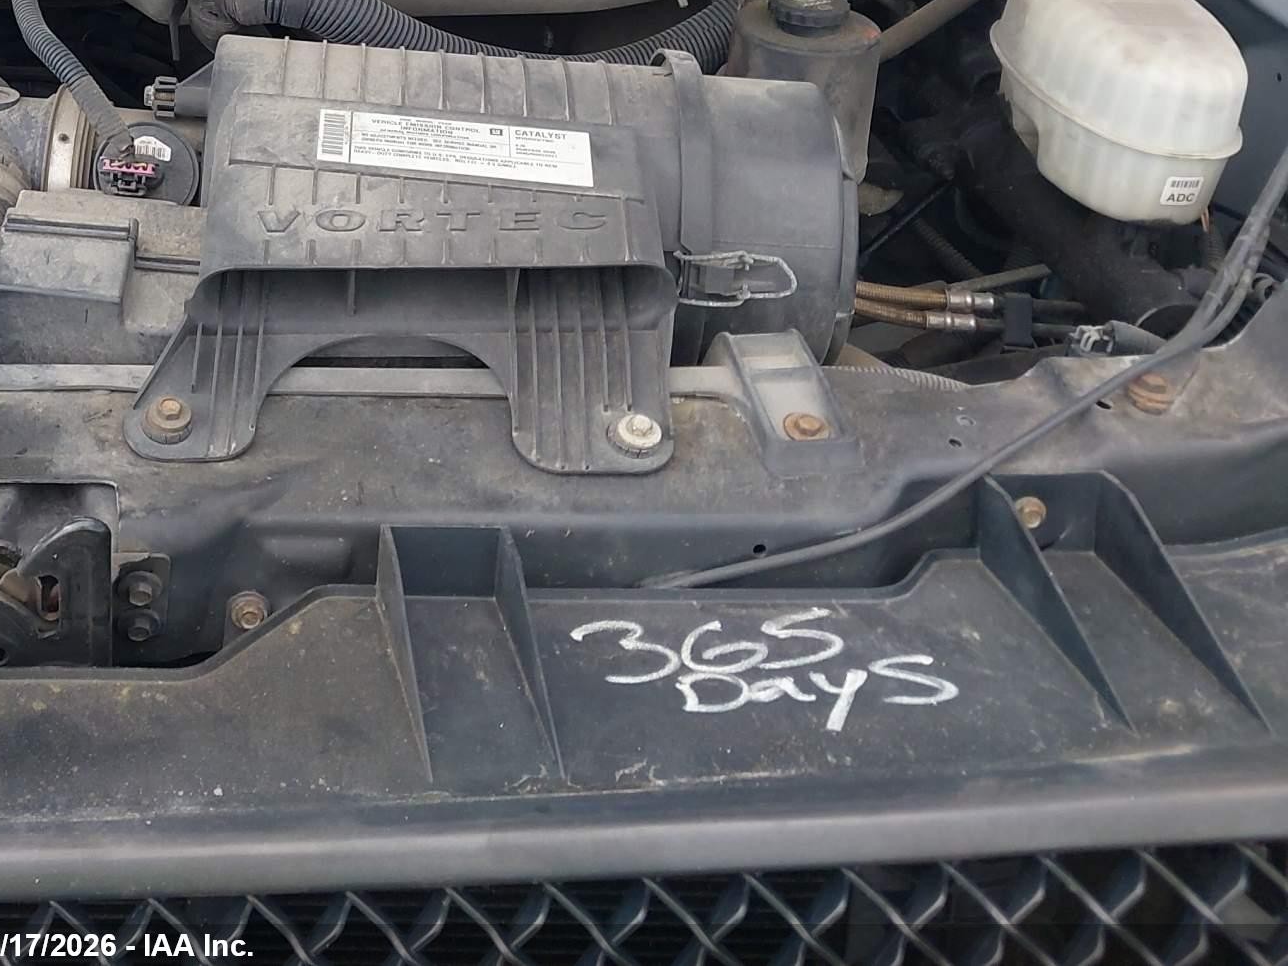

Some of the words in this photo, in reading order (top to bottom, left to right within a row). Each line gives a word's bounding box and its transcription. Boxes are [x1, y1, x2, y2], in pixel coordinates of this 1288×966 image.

[514, 129, 567, 140] CATALYST
[1166, 193, 1196, 203] ADC
[258, 208, 607, 233] VORTEC
[570, 607, 844, 684] 365
